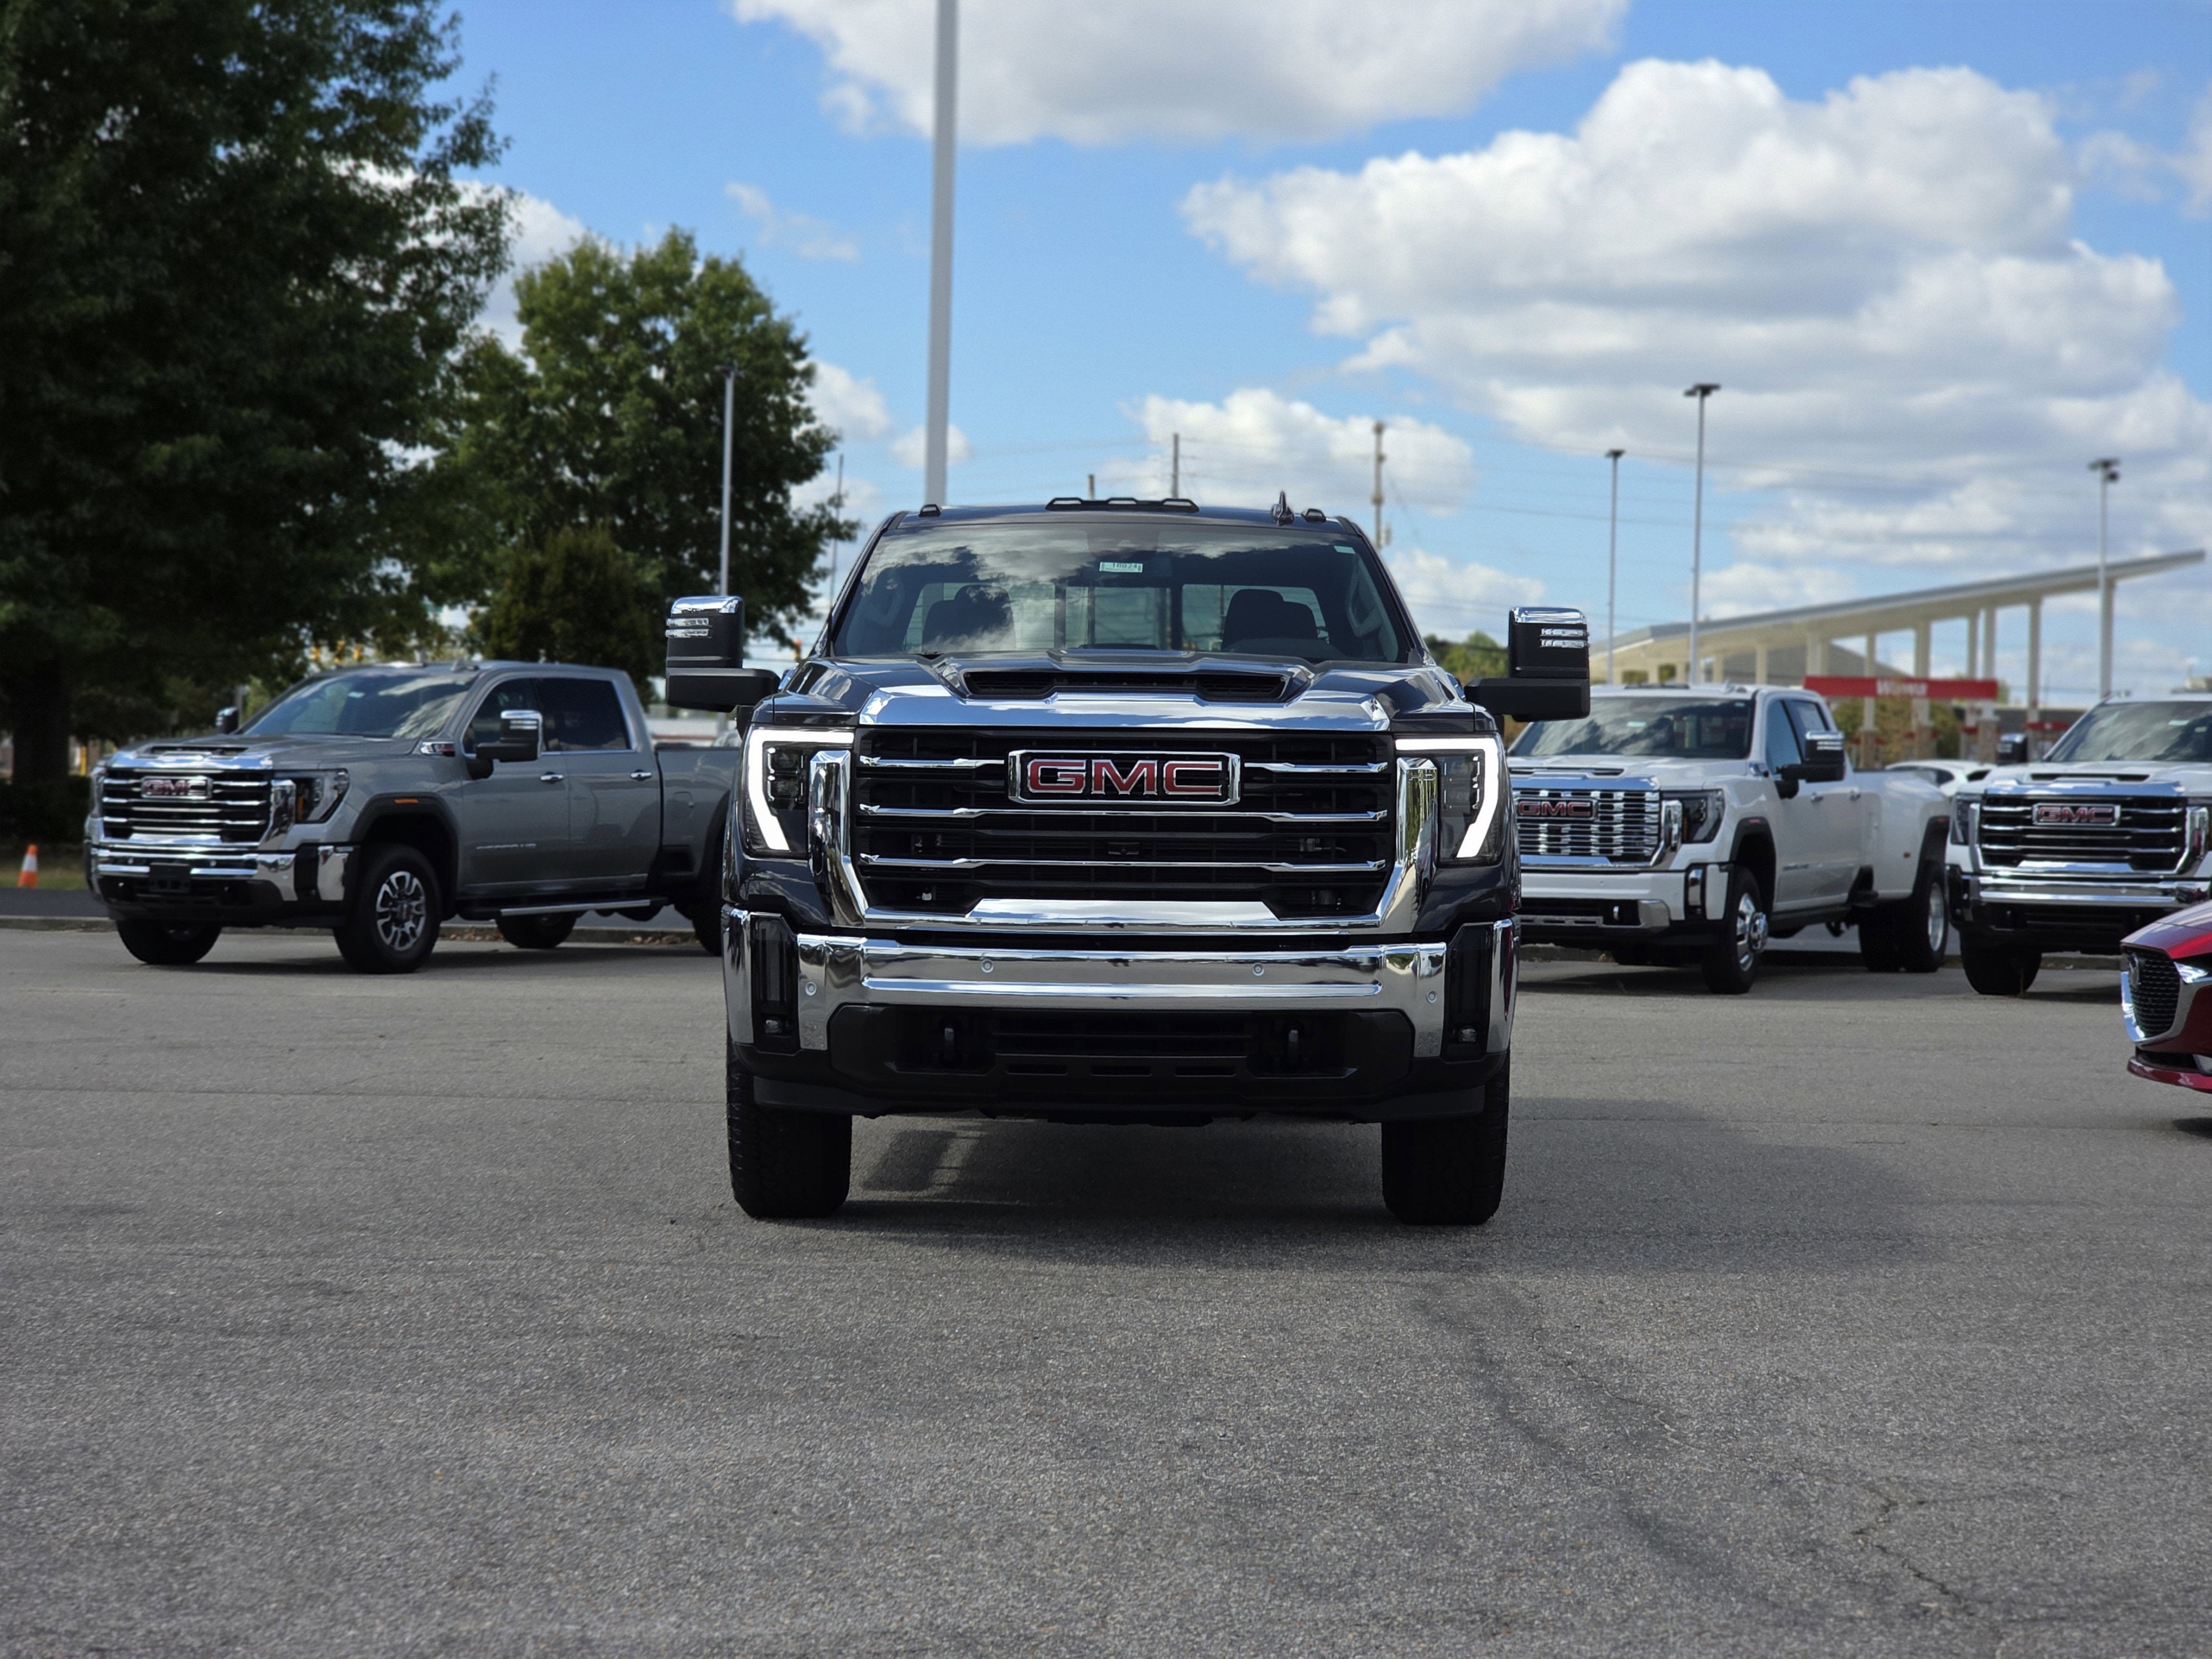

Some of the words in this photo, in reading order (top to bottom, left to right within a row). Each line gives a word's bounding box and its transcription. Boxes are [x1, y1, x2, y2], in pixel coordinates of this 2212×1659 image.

[1027, 759, 1222, 795] GMC
[143, 779, 206, 795] GMC
[1518, 801, 1591, 816] GMC
[2038, 806, 2113, 822] GMC
